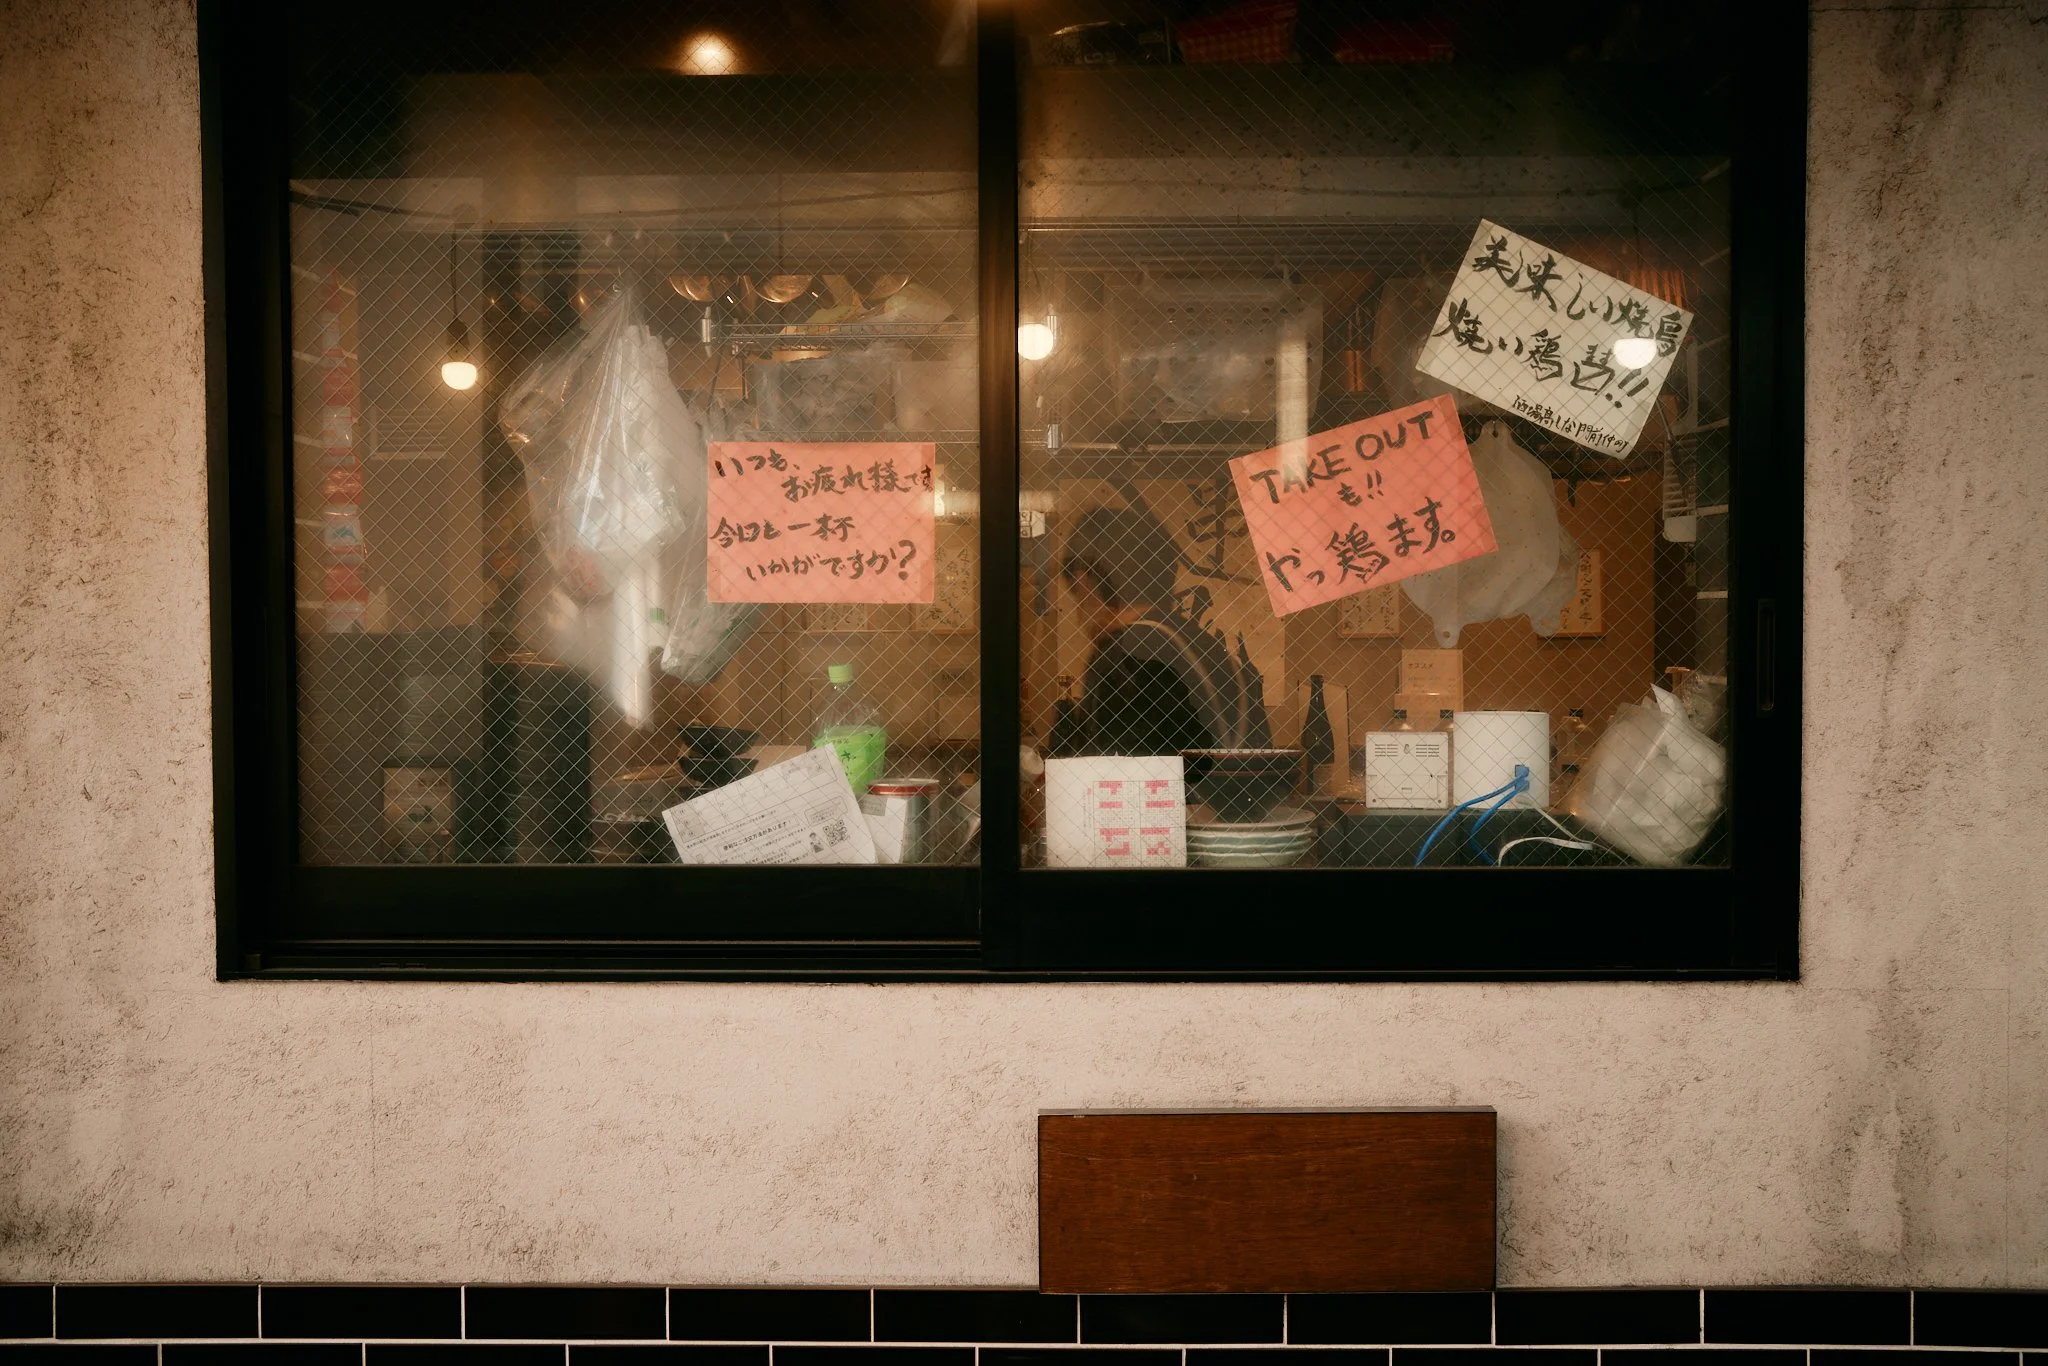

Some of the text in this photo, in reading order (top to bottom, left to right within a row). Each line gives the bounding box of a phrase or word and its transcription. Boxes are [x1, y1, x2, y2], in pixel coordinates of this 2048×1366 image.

[1249, 410, 1434, 504] TAKE OUT
[745, 539, 917, 582] いかがですか?
